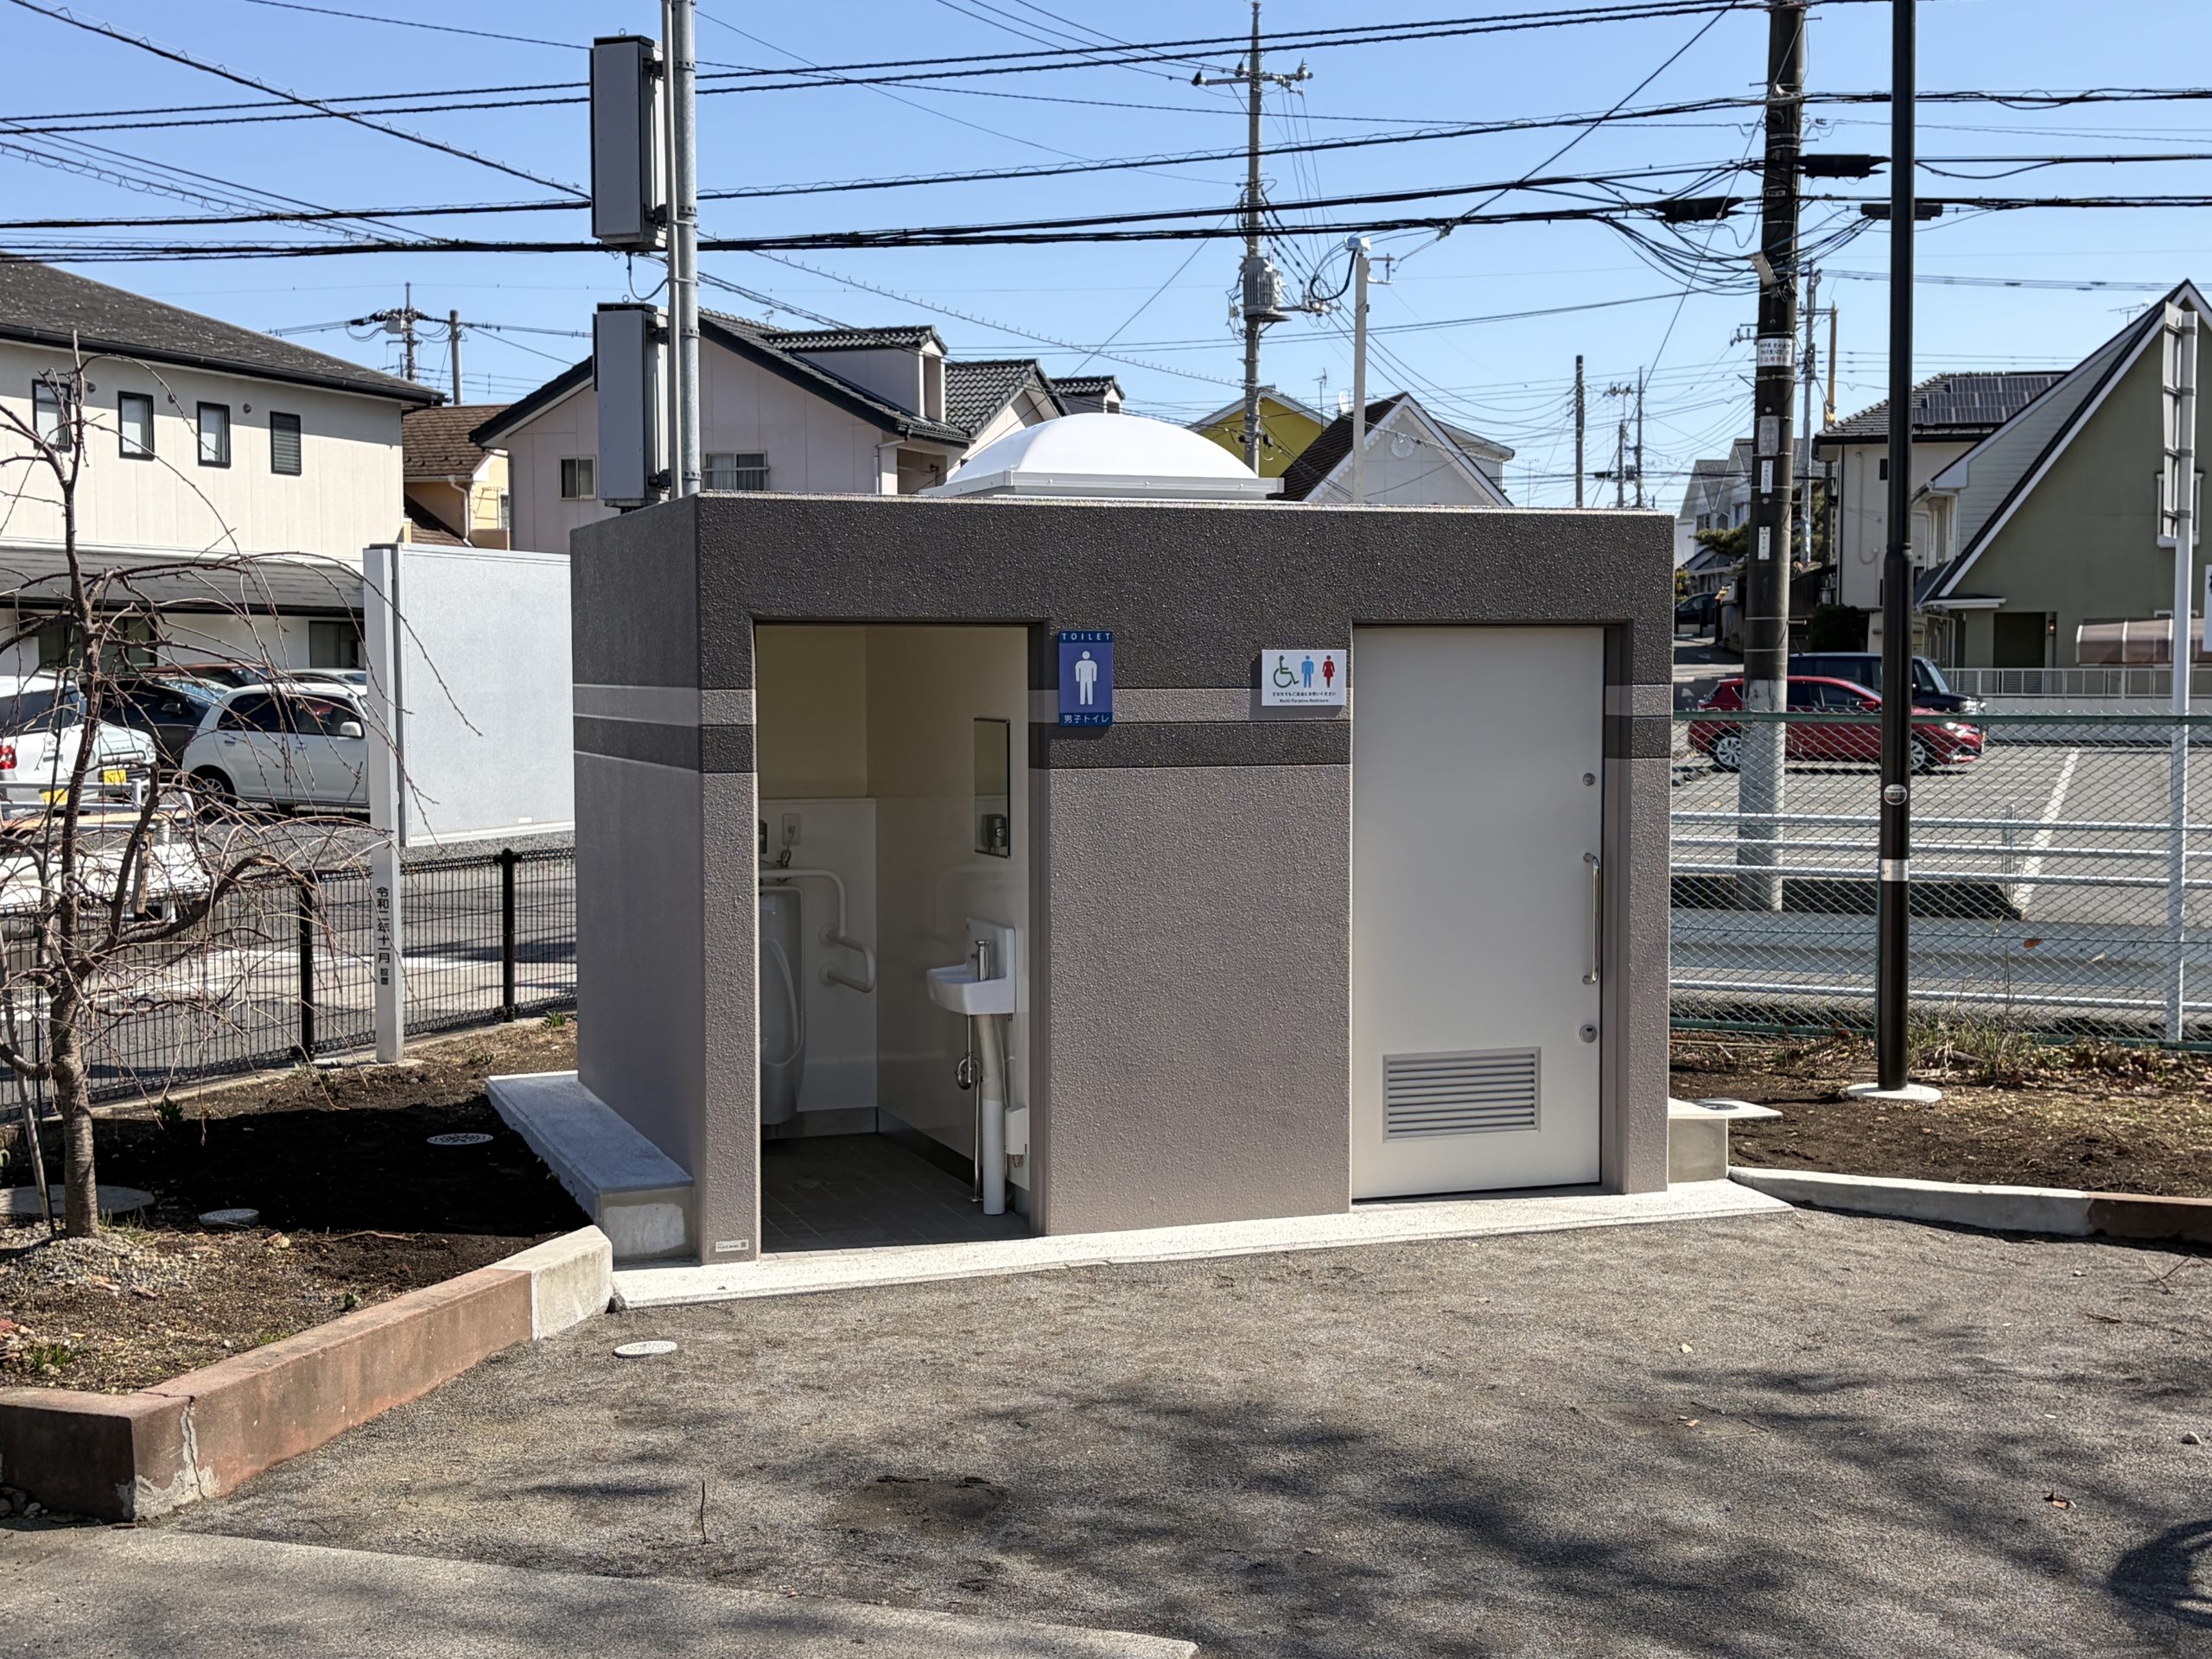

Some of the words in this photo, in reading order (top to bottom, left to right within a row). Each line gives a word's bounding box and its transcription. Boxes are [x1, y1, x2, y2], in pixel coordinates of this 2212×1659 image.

[1064, 714, 1109, 724] 男子トイレ
